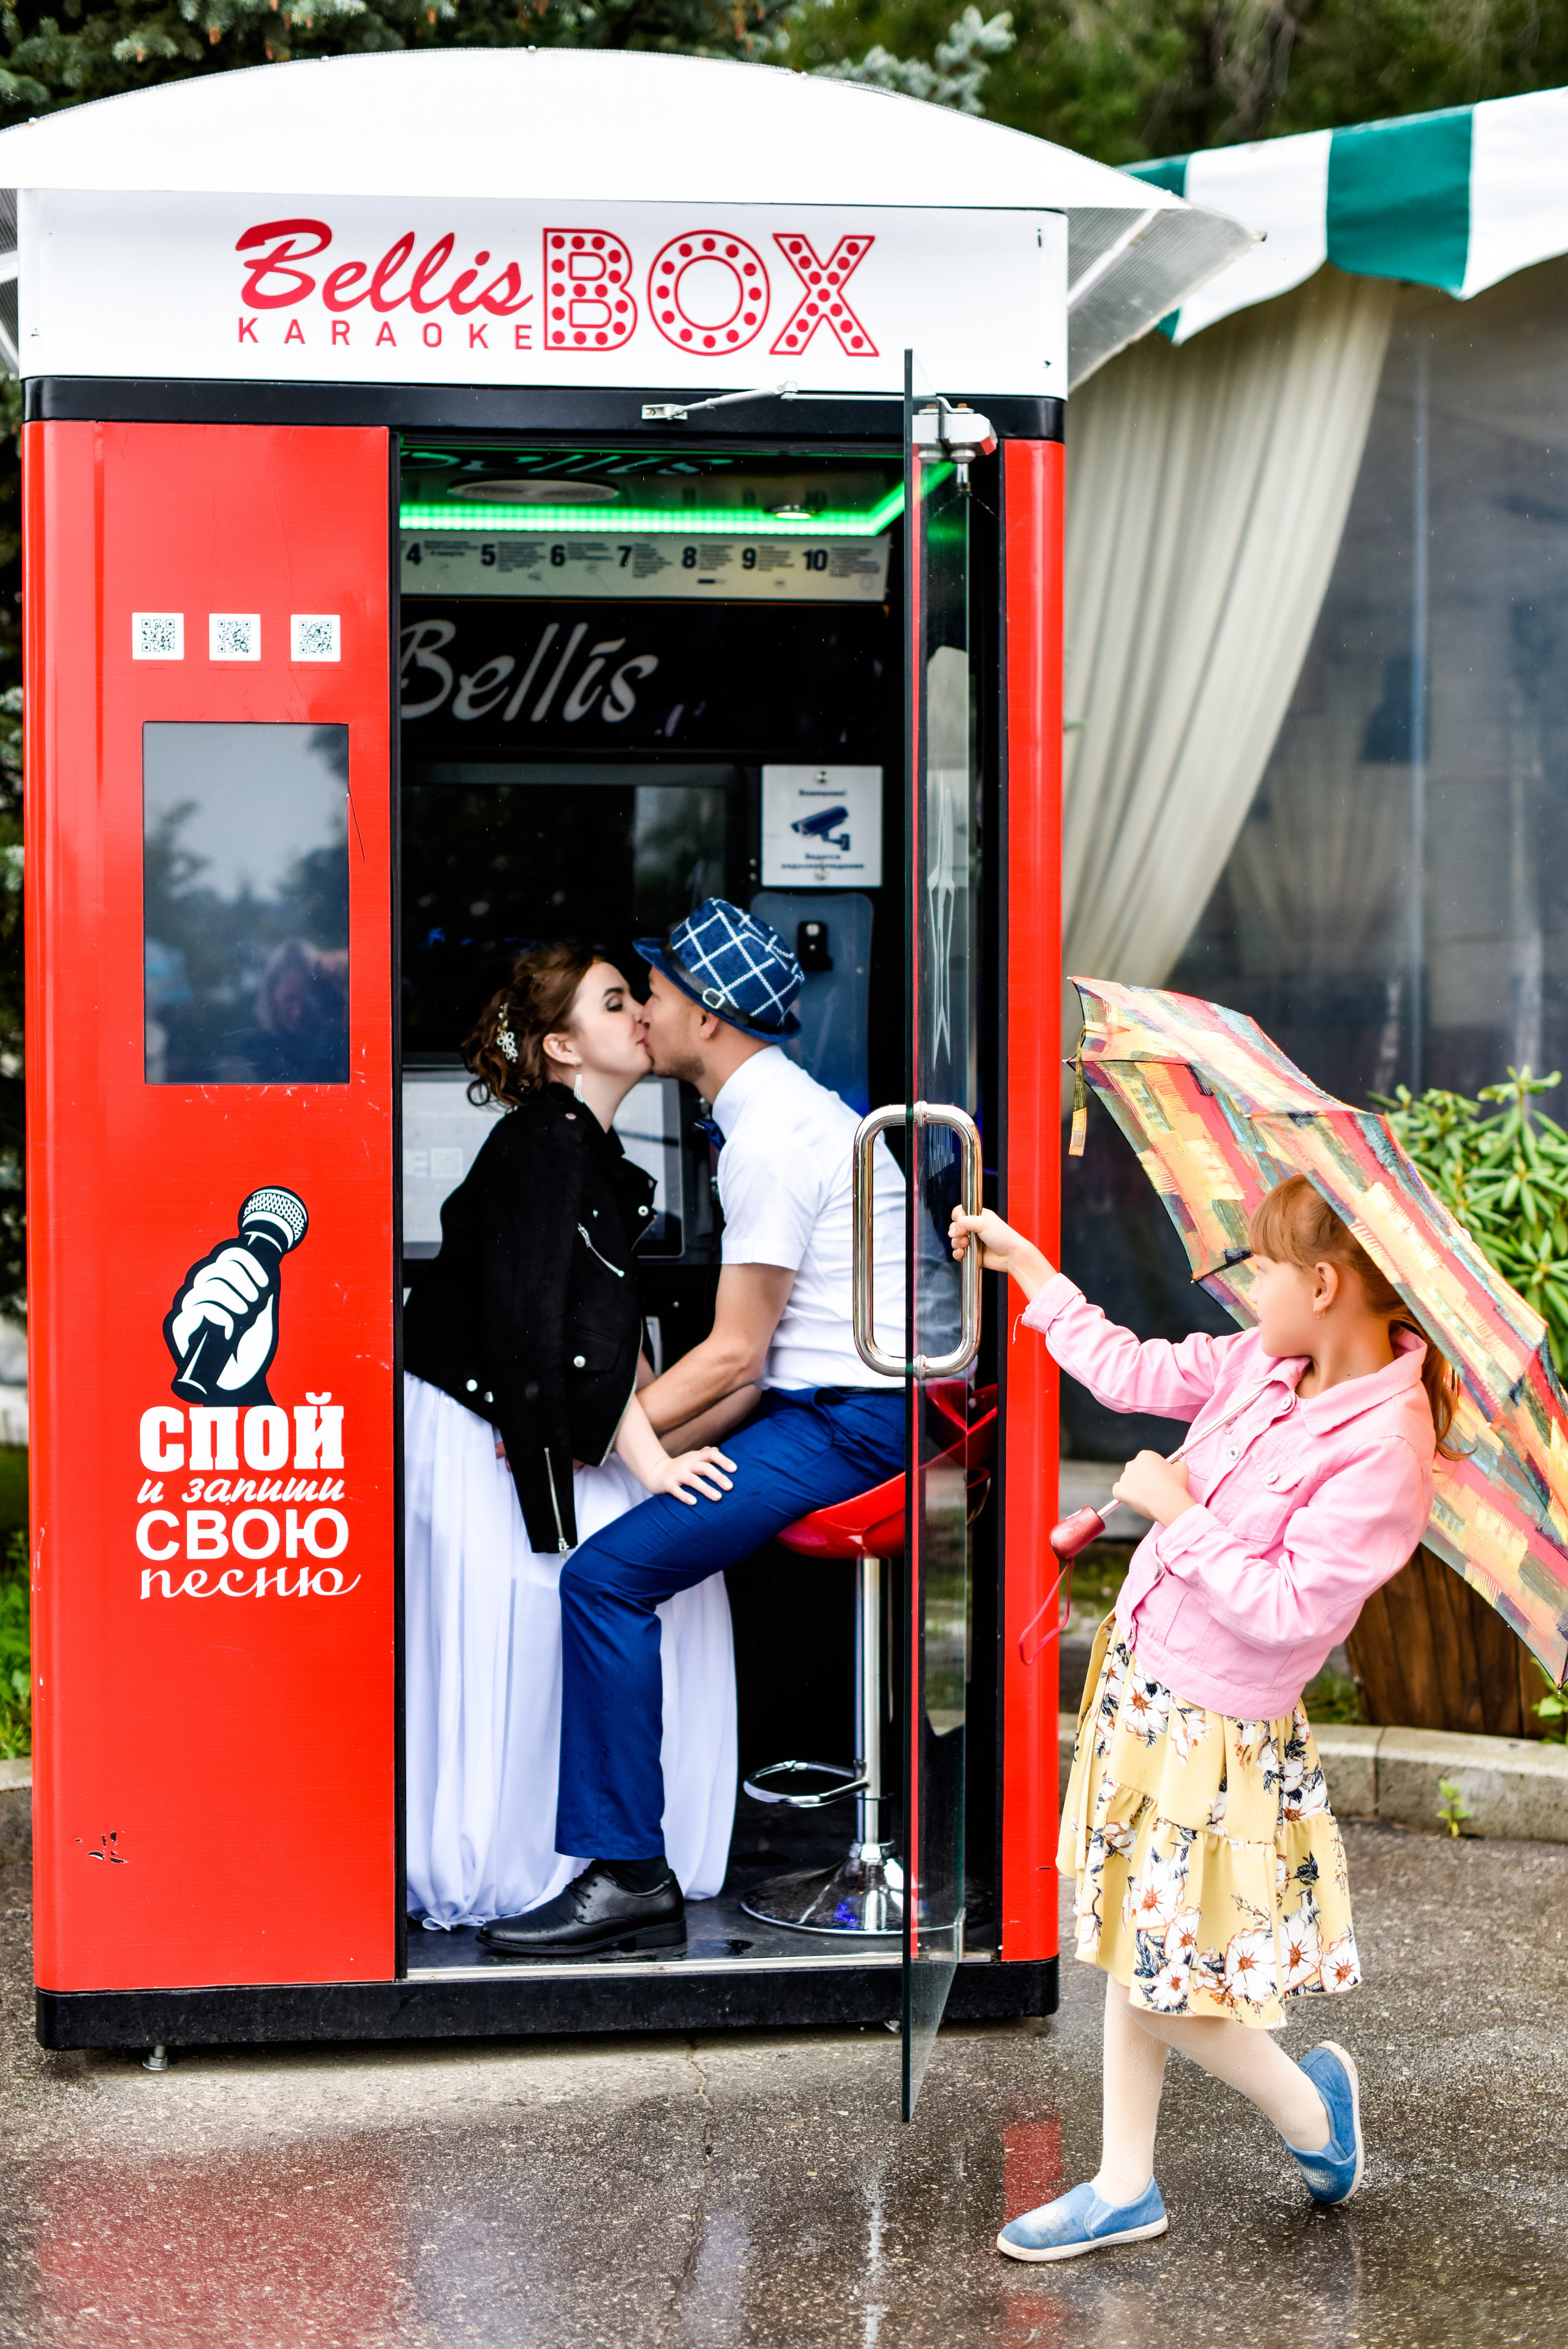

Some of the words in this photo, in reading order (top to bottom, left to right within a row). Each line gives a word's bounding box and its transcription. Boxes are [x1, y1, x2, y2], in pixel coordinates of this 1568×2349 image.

[235, 219, 533, 316] Bellis
[543, 227, 880, 357] BOX
[237, 317, 532, 350] KARAOKE
[405, 543, 422, 565] 4
[481, 544, 496, 566] 5
[551, 545, 565, 567] 6
[617, 546, 633, 567] 7
[682, 546, 697, 568] 8
[742, 548, 756, 570] 9
[802, 549, 827, 571] 10
[400, 620, 658, 722] Bellis
[140, 1392, 344, 1472] СПОЙ
[137, 1478, 164, 1504] и
[181, 1476, 345, 1504] запиши
[135, 1507, 349, 1561] СВОЮ
[140, 1566, 361, 1600] песню
